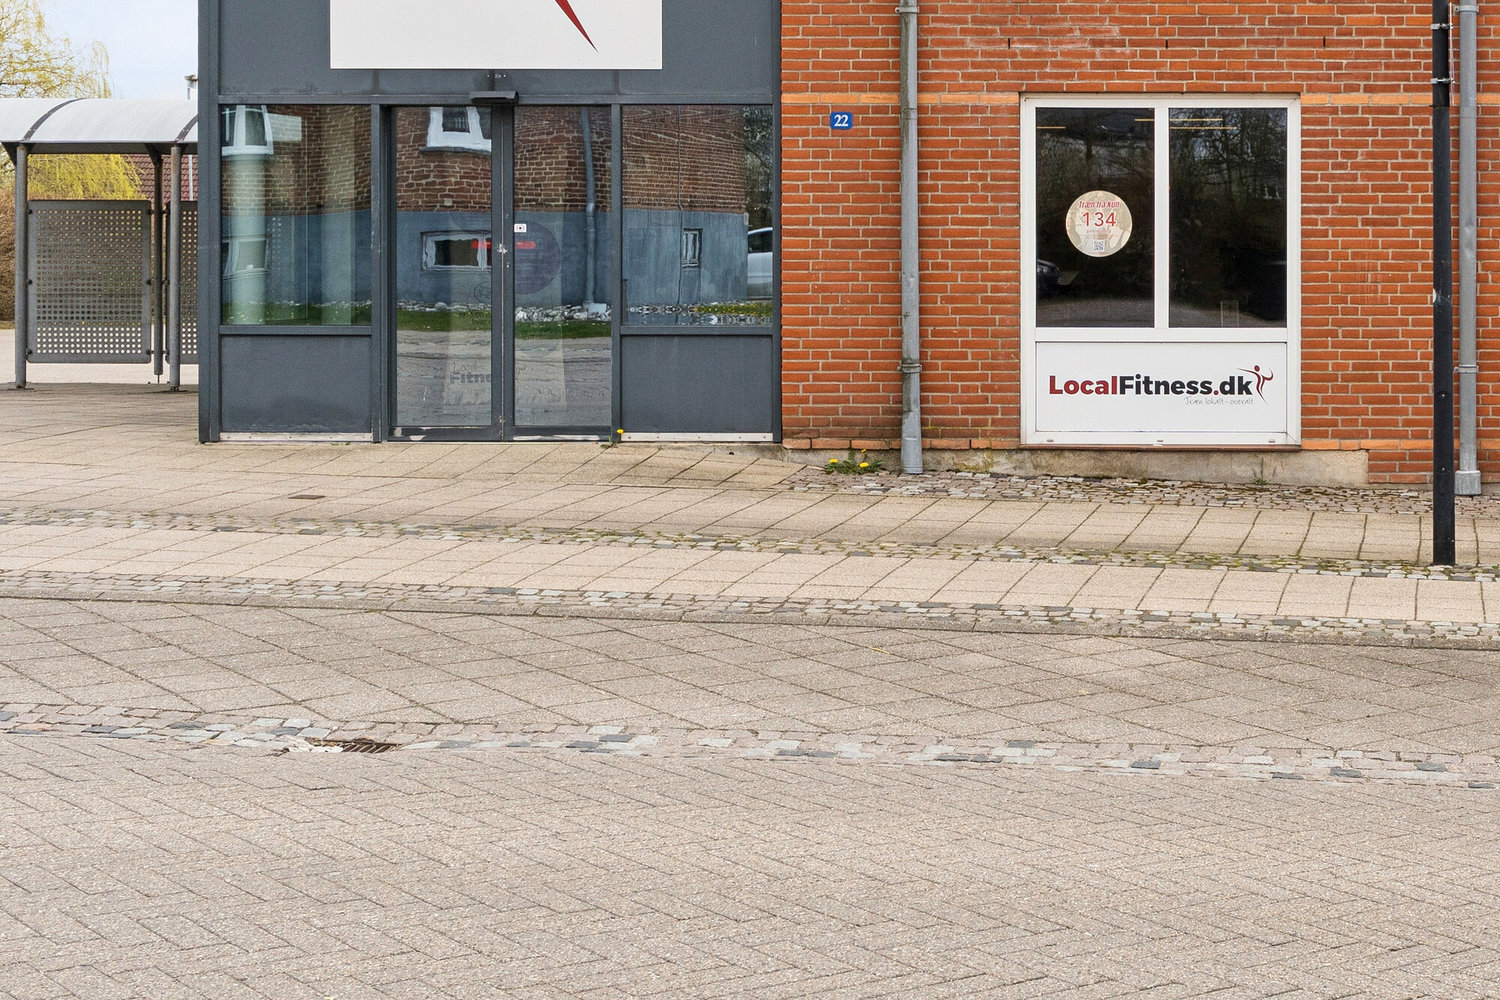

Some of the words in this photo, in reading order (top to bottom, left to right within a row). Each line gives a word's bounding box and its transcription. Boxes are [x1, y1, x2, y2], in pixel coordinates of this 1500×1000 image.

[834, 114, 849, 127] 22
[1082, 211, 1116, 227] 134
[1049, 374, 1253, 396] LocalFitness.dk
[1205, 396, 1224, 405] lokalt
